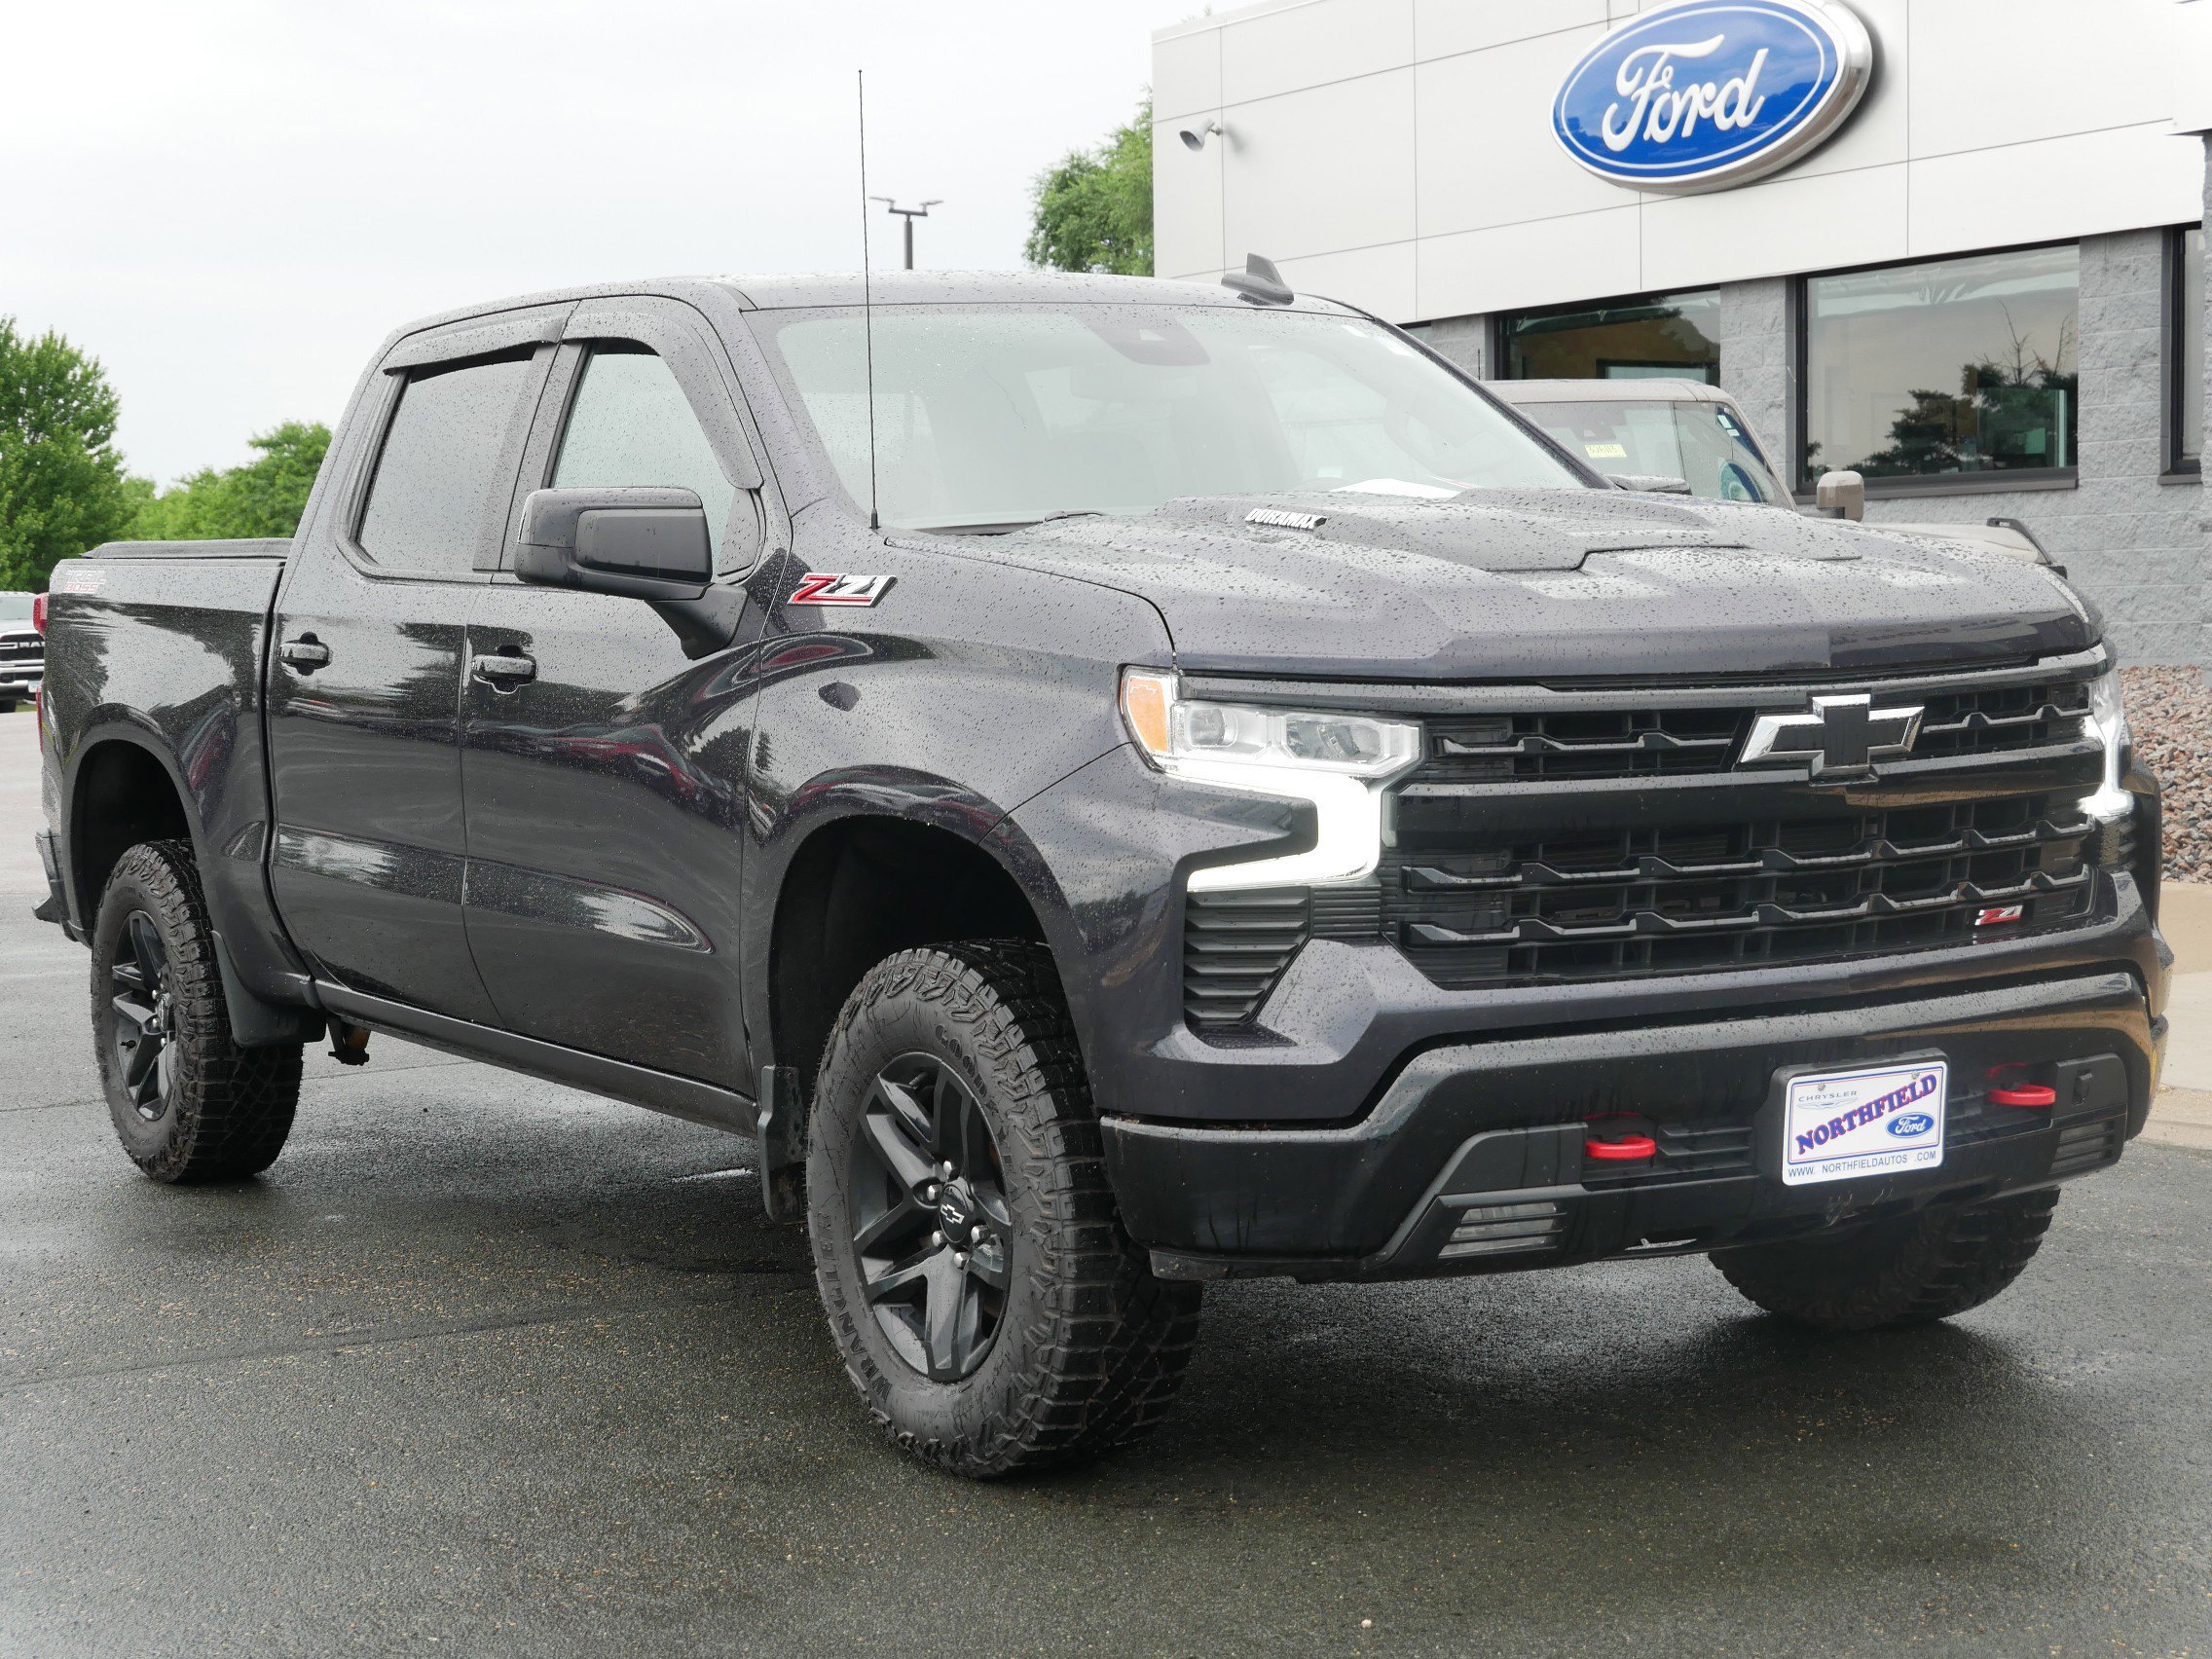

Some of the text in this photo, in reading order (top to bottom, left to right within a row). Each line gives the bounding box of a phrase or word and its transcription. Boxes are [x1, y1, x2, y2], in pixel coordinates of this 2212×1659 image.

[1602, 33, 1769, 152] Ford
[1245, 508, 1327, 530] DURAMAX
[63, 582, 98, 594] BOSS
[787, 572, 897, 607] Z71
[1974, 904, 2023, 926] Z71
[1798, 1090, 1858, 1102] CHRYSLER
[1795, 1074, 1936, 1155] NORTHFIELD
[1895, 1115, 1926, 1134] Ford
[1822, 1154, 1907, 1173] NORTHFIELDAUTOS
[817, 1213, 893, 1403] WRANGLER
